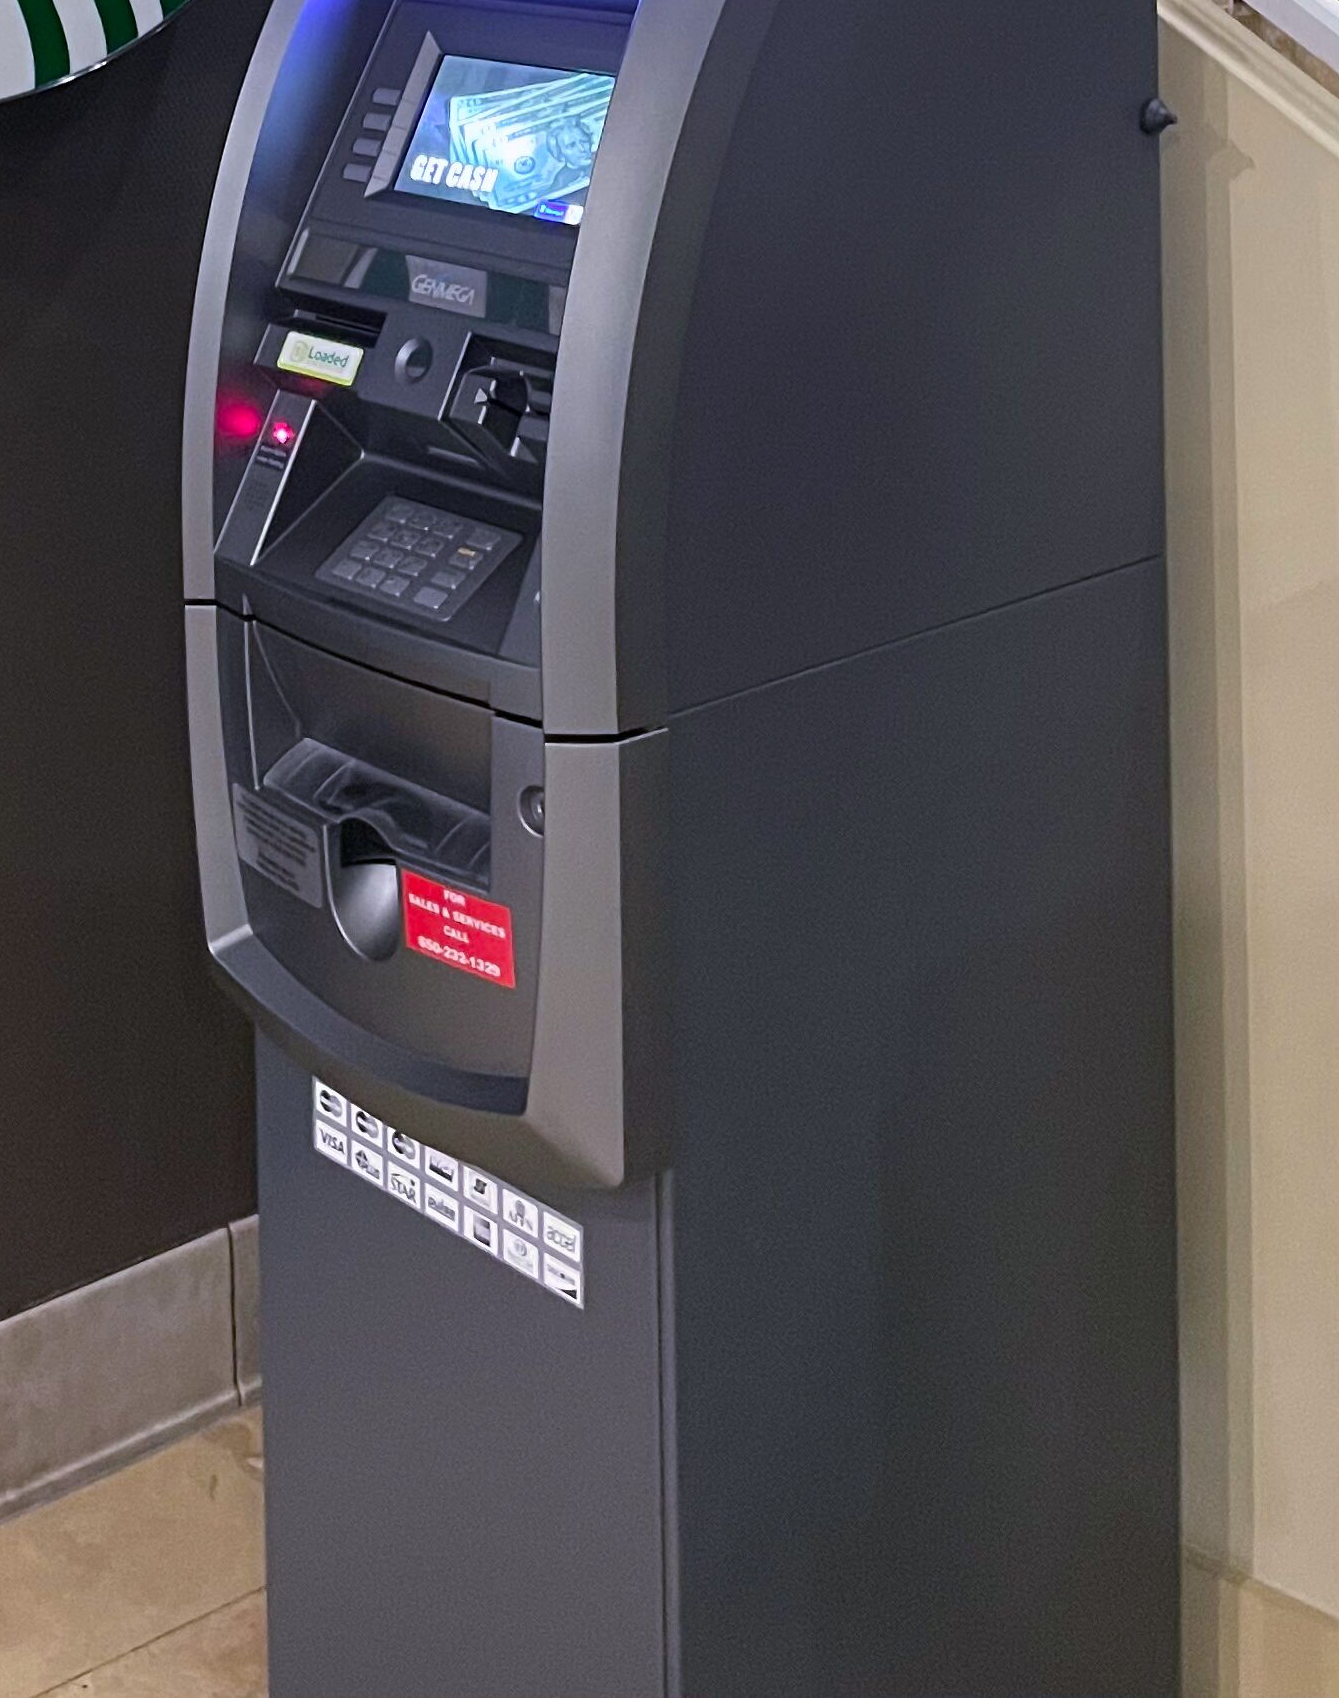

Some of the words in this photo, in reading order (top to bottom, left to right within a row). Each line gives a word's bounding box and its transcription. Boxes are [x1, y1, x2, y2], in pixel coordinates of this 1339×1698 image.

[411, 155, 448, 184] GET
[446, 161, 499, 193] CASH
[308, 346, 350, 368] Loaded
[443, 890, 466, 906] FOR
[408, 893, 440, 915] SALES
[452, 911, 506, 939] SERVICES
[443, 925, 470, 943] CALL
[319, 1127, 345, 1155] VISA
[391, 1177, 417, 1204] STAR
